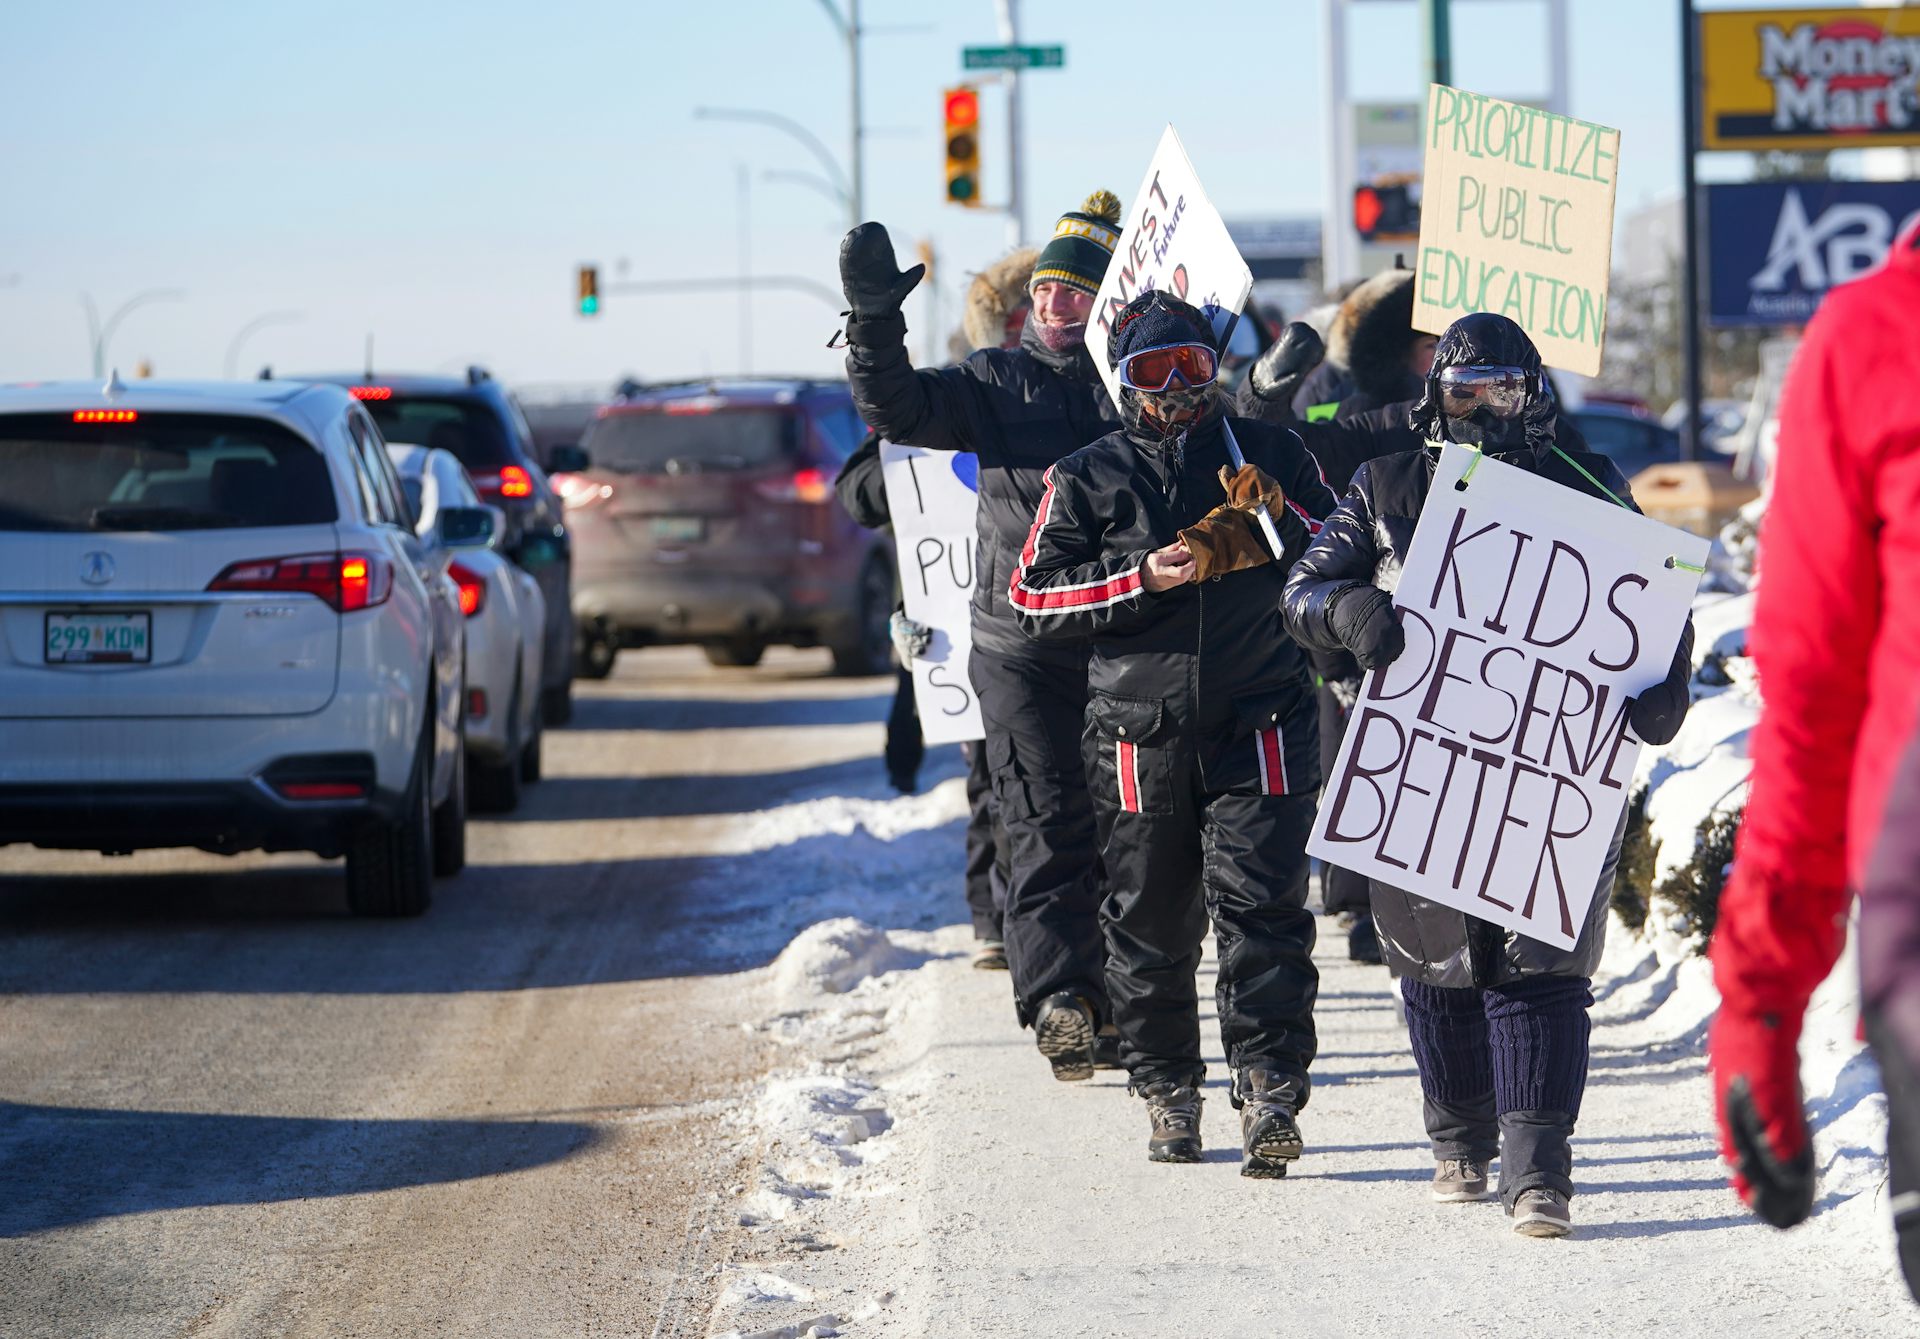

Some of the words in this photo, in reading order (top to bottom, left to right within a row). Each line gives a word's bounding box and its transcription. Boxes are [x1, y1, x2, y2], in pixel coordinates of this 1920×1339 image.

[1433, 86, 1617, 185] PRIORITIZE
[1773, 78, 1907, 131] Mart
[1097, 169, 1168, 335] INVEST
[1152, 194, 1186, 267] future
[1456, 175, 1574, 254] PUBLIC
[1420, 246, 1605, 348] EDUCATION
[907, 454, 925, 515] I
[50, 626, 91, 651] 299
[104, 626, 146, 651] KDW
[1429, 506, 1649, 672] KIDS
[1366, 604, 1638, 790] DESERVE
[1322, 706, 1594, 940] BETTER
